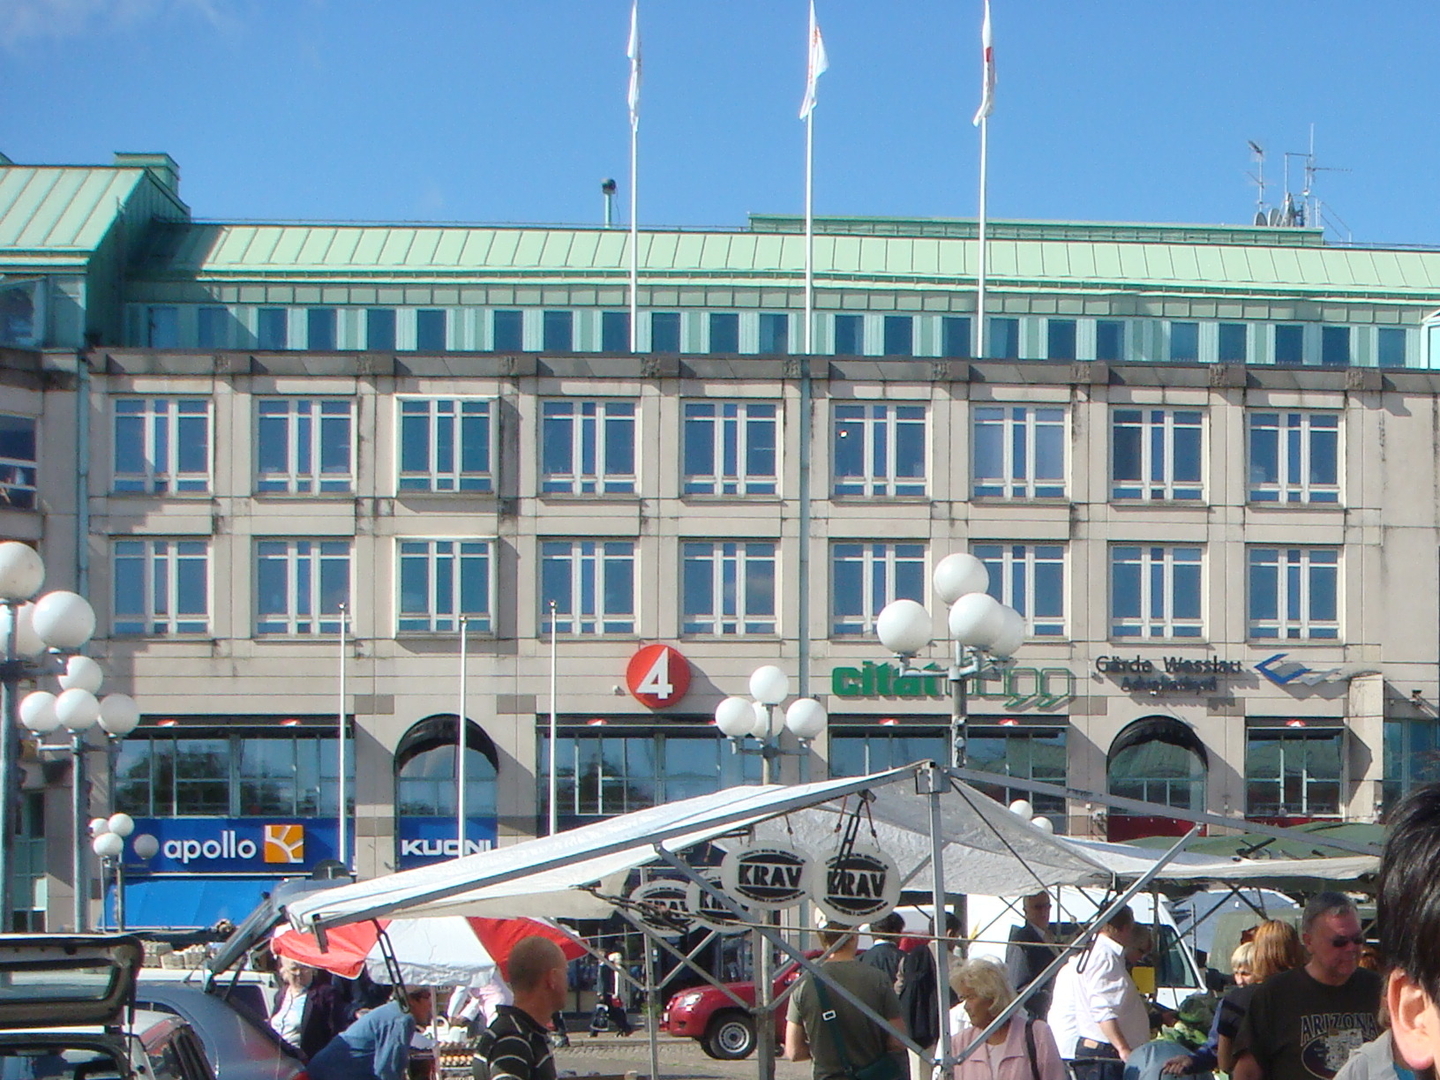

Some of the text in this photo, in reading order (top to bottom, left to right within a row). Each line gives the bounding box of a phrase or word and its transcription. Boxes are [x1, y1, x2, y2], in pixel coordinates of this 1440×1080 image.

[635, 646, 673, 699] 4
[163, 830, 257, 864] apollo
[738, 864, 803, 888] KRAV
[827, 870, 886, 898] KRAV
[1299, 1013, 1379, 1046] ARIZONA
